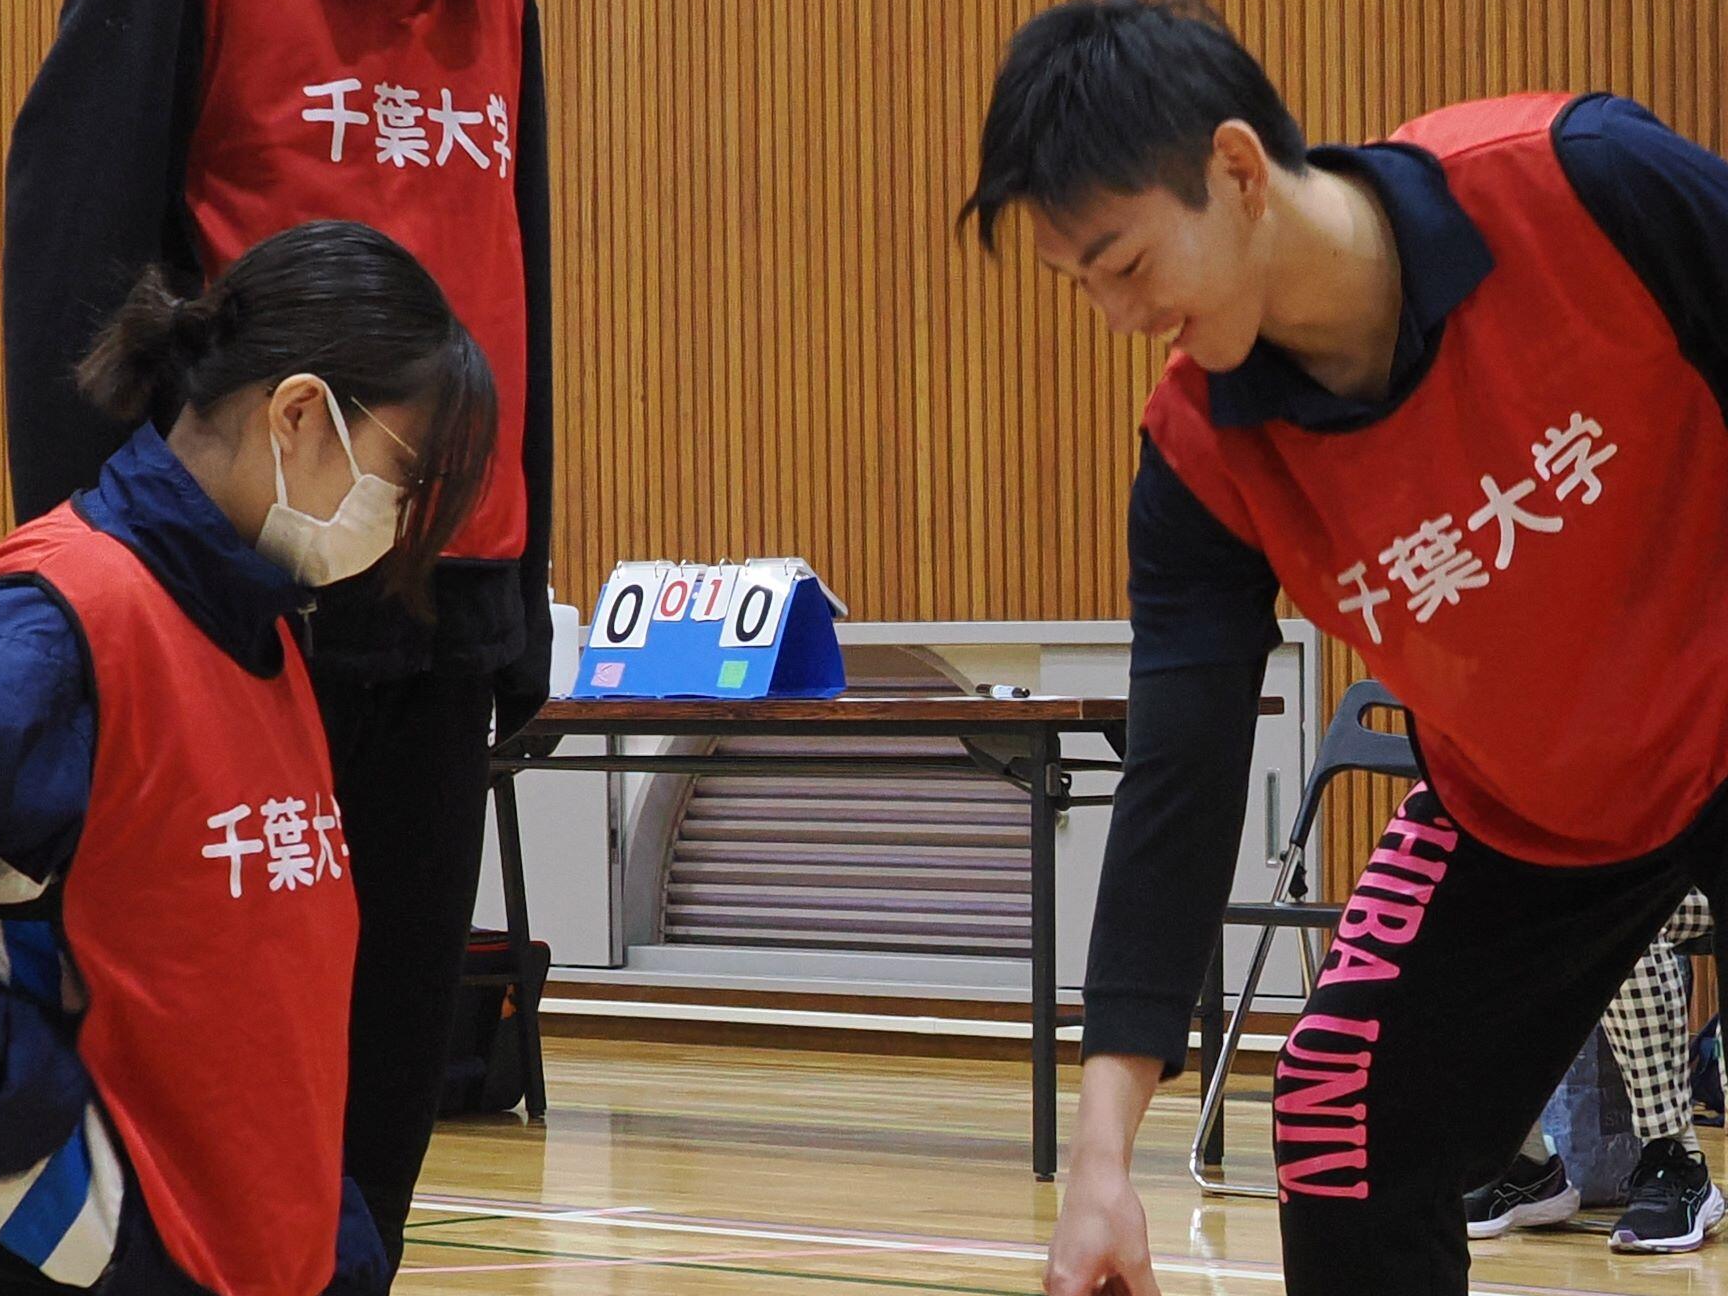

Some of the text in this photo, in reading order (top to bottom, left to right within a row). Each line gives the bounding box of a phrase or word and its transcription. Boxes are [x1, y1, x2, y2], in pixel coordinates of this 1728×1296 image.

[301, 77, 512, 179] 千葉大学
[1337, 410, 1619, 644] 千葉大学
[606, 579, 773, 644] 0 0 1 0
[201, 791, 350, 899] 千葉大
[1275, 1013, 1381, 1204] UNIV.
